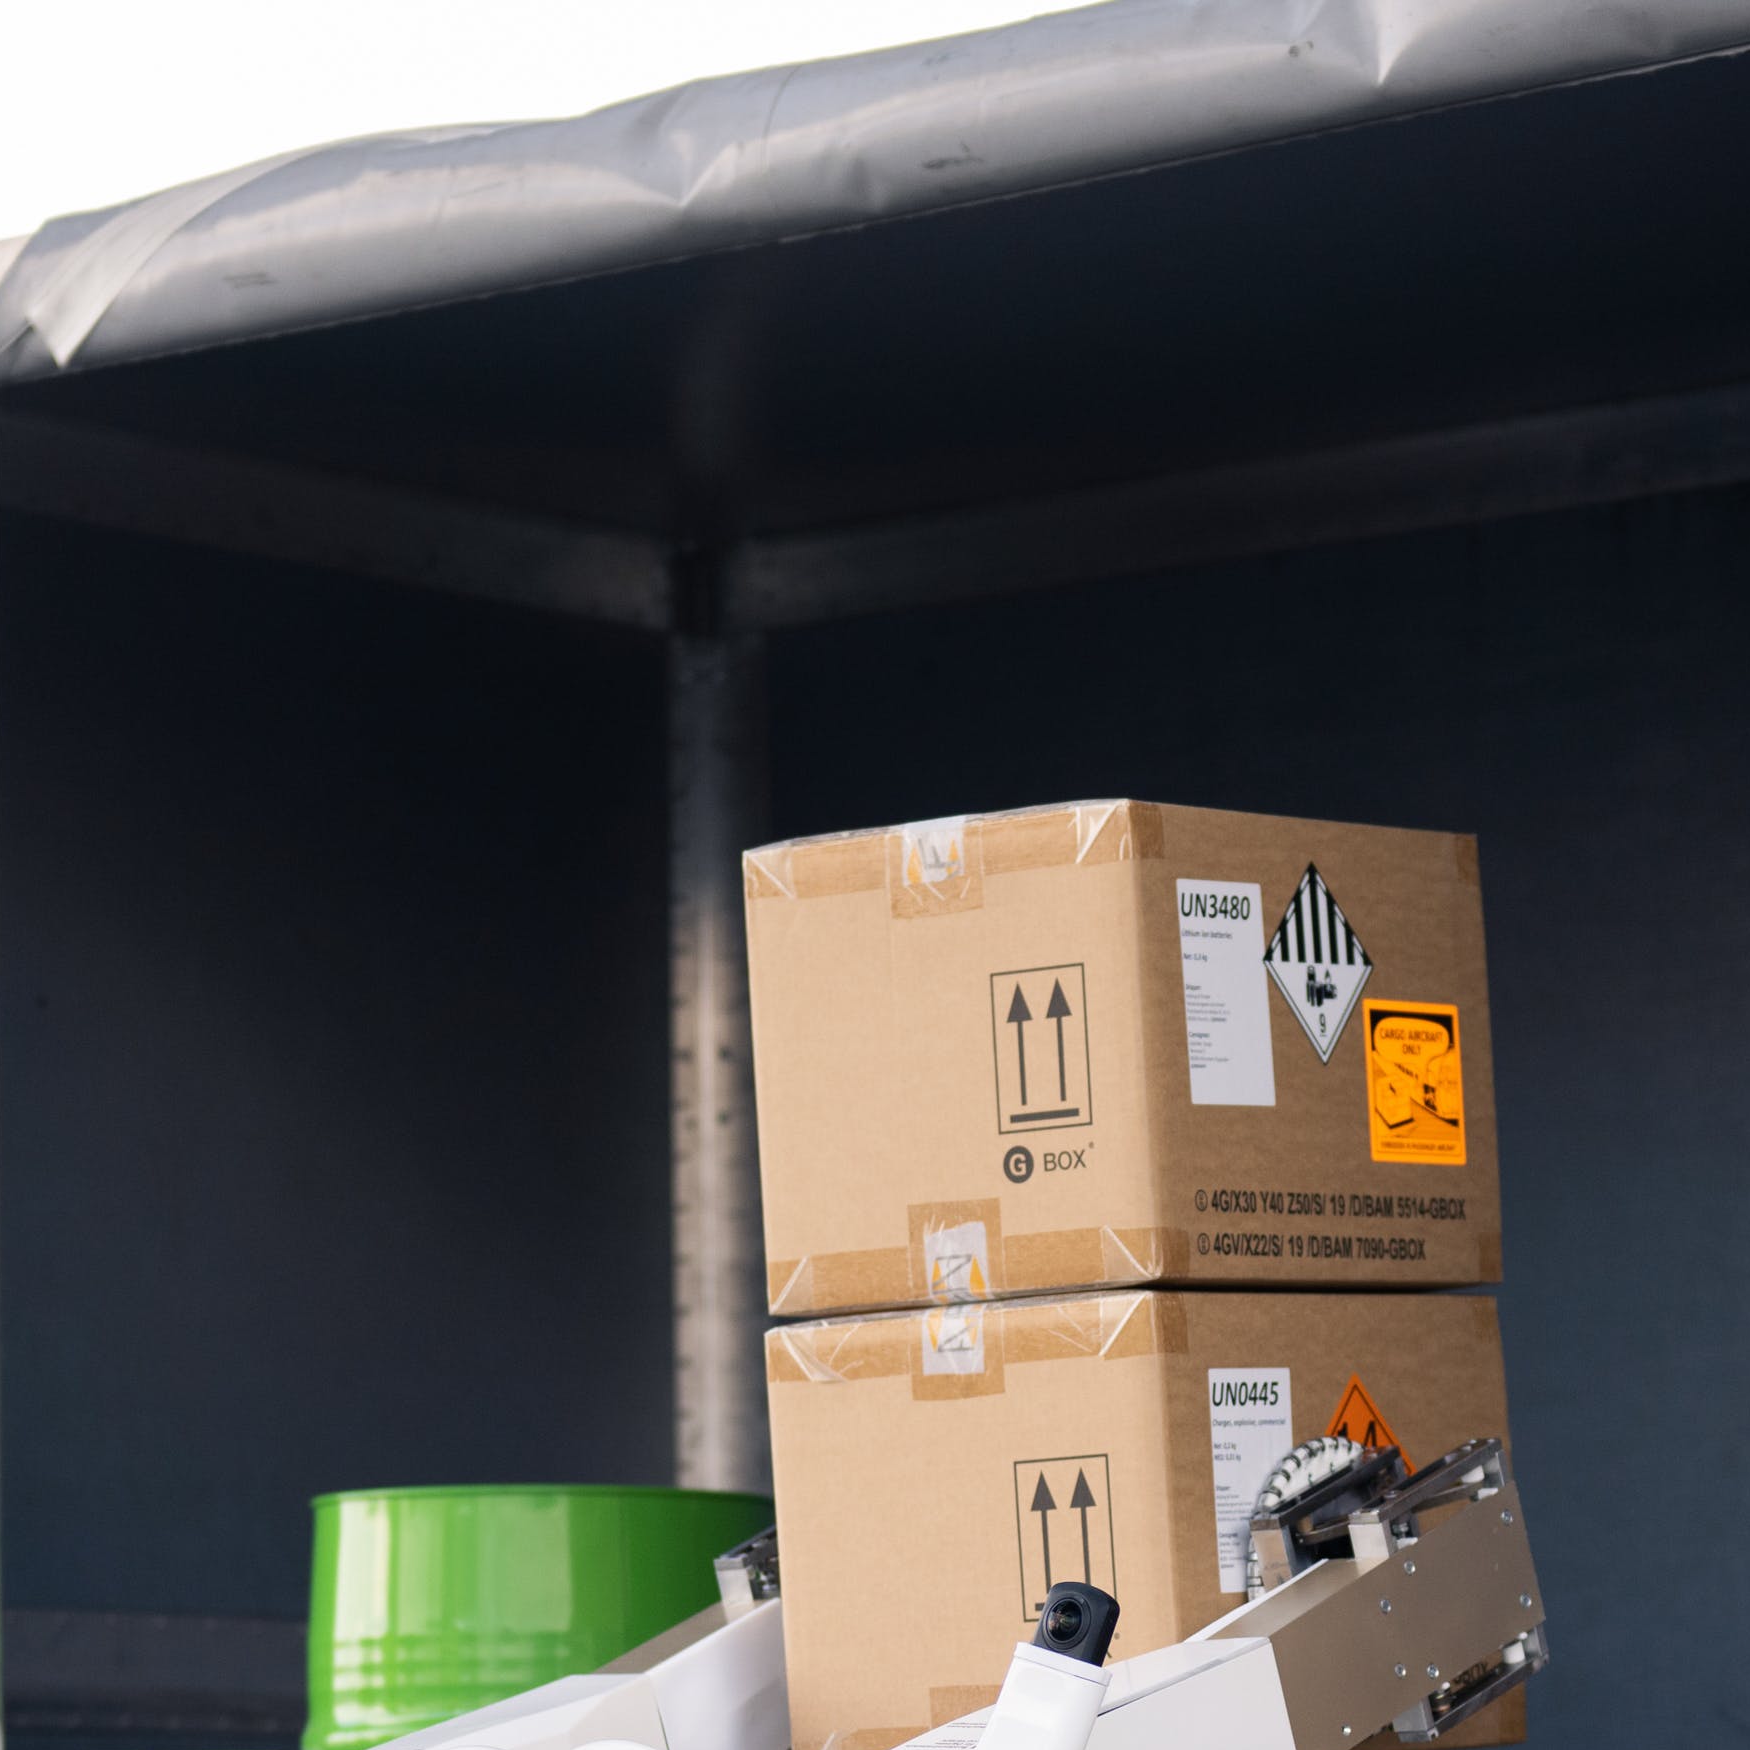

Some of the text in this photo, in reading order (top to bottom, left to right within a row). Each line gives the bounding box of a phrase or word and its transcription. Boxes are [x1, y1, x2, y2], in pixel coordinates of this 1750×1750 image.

[1180, 892, 1250, 921] UN3480
[1318, 1013, 1326, 1033] 9
[1380, 1028, 1443, 1043] CARGO AIRCRAFT
[1402, 1044, 1422, 1056] ONLY
[1211, 1189, 1257, 1214] 4G/X30
[1260, 1191, 1284, 1214] Y40
[1330, 1192, 1346, 1216] 19
[1397, 1196, 1467, 1220] 5514-GBOX
[1287, 1235, 1304, 1258] 19
[1356, 1237, 1426, 1261] 7090-GBOX
[1212, 1381, 1279, 1407] UN0445
